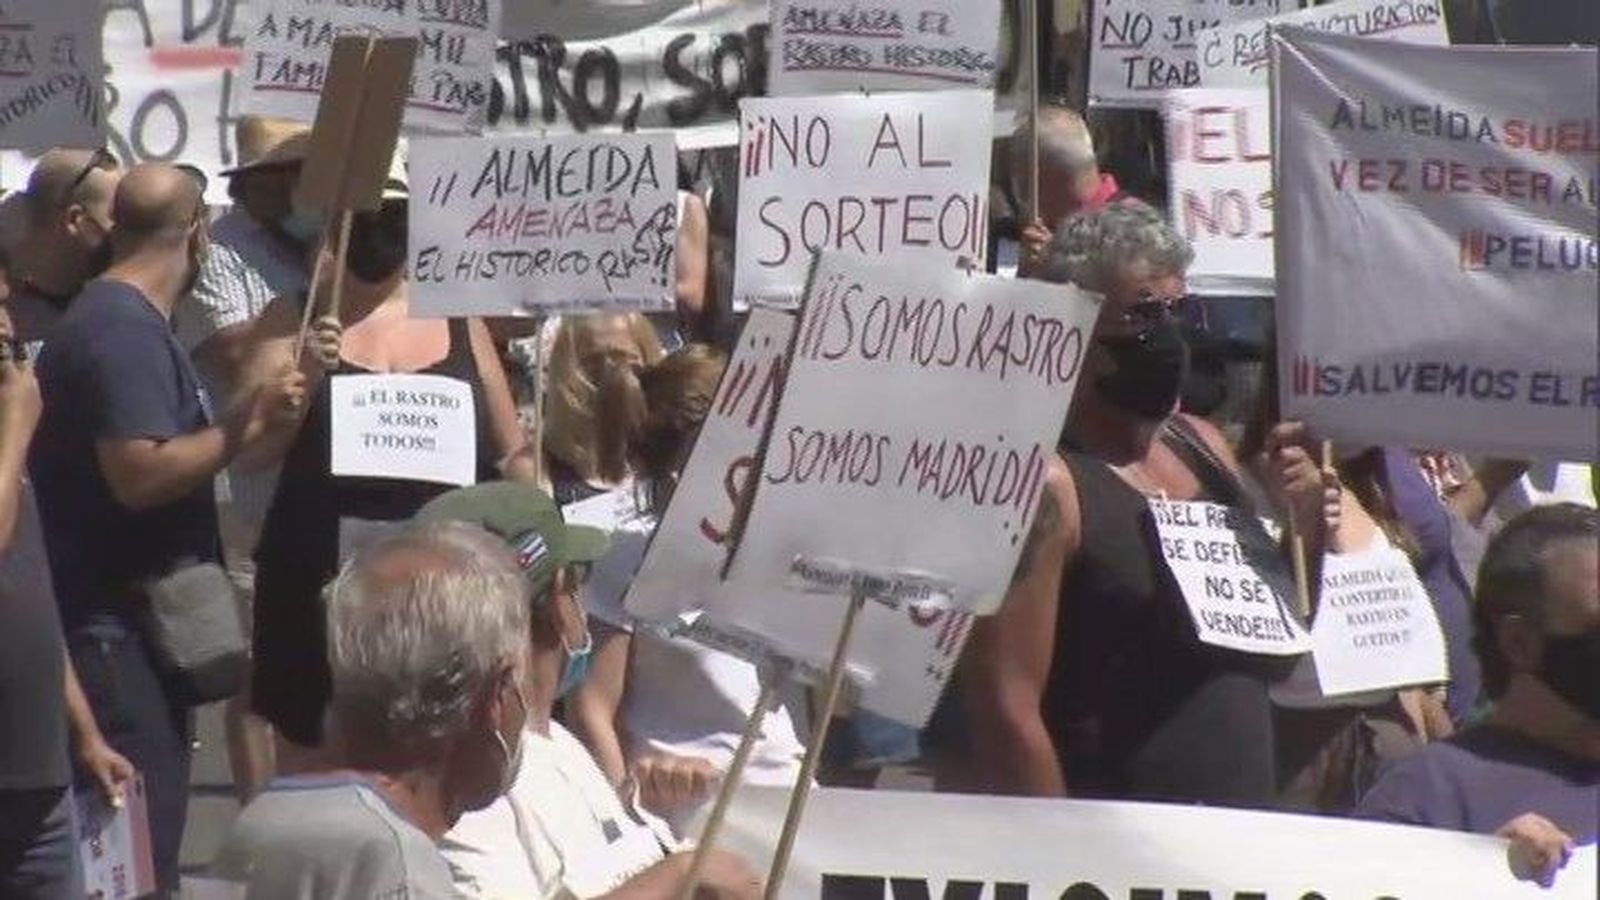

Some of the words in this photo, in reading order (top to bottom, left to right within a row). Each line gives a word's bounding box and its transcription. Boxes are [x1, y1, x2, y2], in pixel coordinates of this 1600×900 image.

[1102, 12, 1153, 48] NO
[868, 113, 953, 169] AL
[1331, 98, 1499, 144] ALMEIDA
[470, 143, 660, 201] ALMEIDA
[1330, 156, 1410, 194] VEZ
[1420, 157, 1473, 194] DE
[1479, 164, 1556, 207] SER
[465, 198, 638, 244] AMENAZA
[415, 245, 446, 284] EL
[454, 248, 591, 280] HISTORICO
[965, 303, 1083, 386] RASTRO
[395, 390, 461, 410] RASTRO
[1528, 370, 1572, 408] EL
[377, 411, 440, 429] SOMOS
[765, 425, 891, 487] SOMOS
[1162, 536, 1190, 562] SE
[1205, 575, 1234, 601] NO
[1239, 578, 1267, 603] SE
